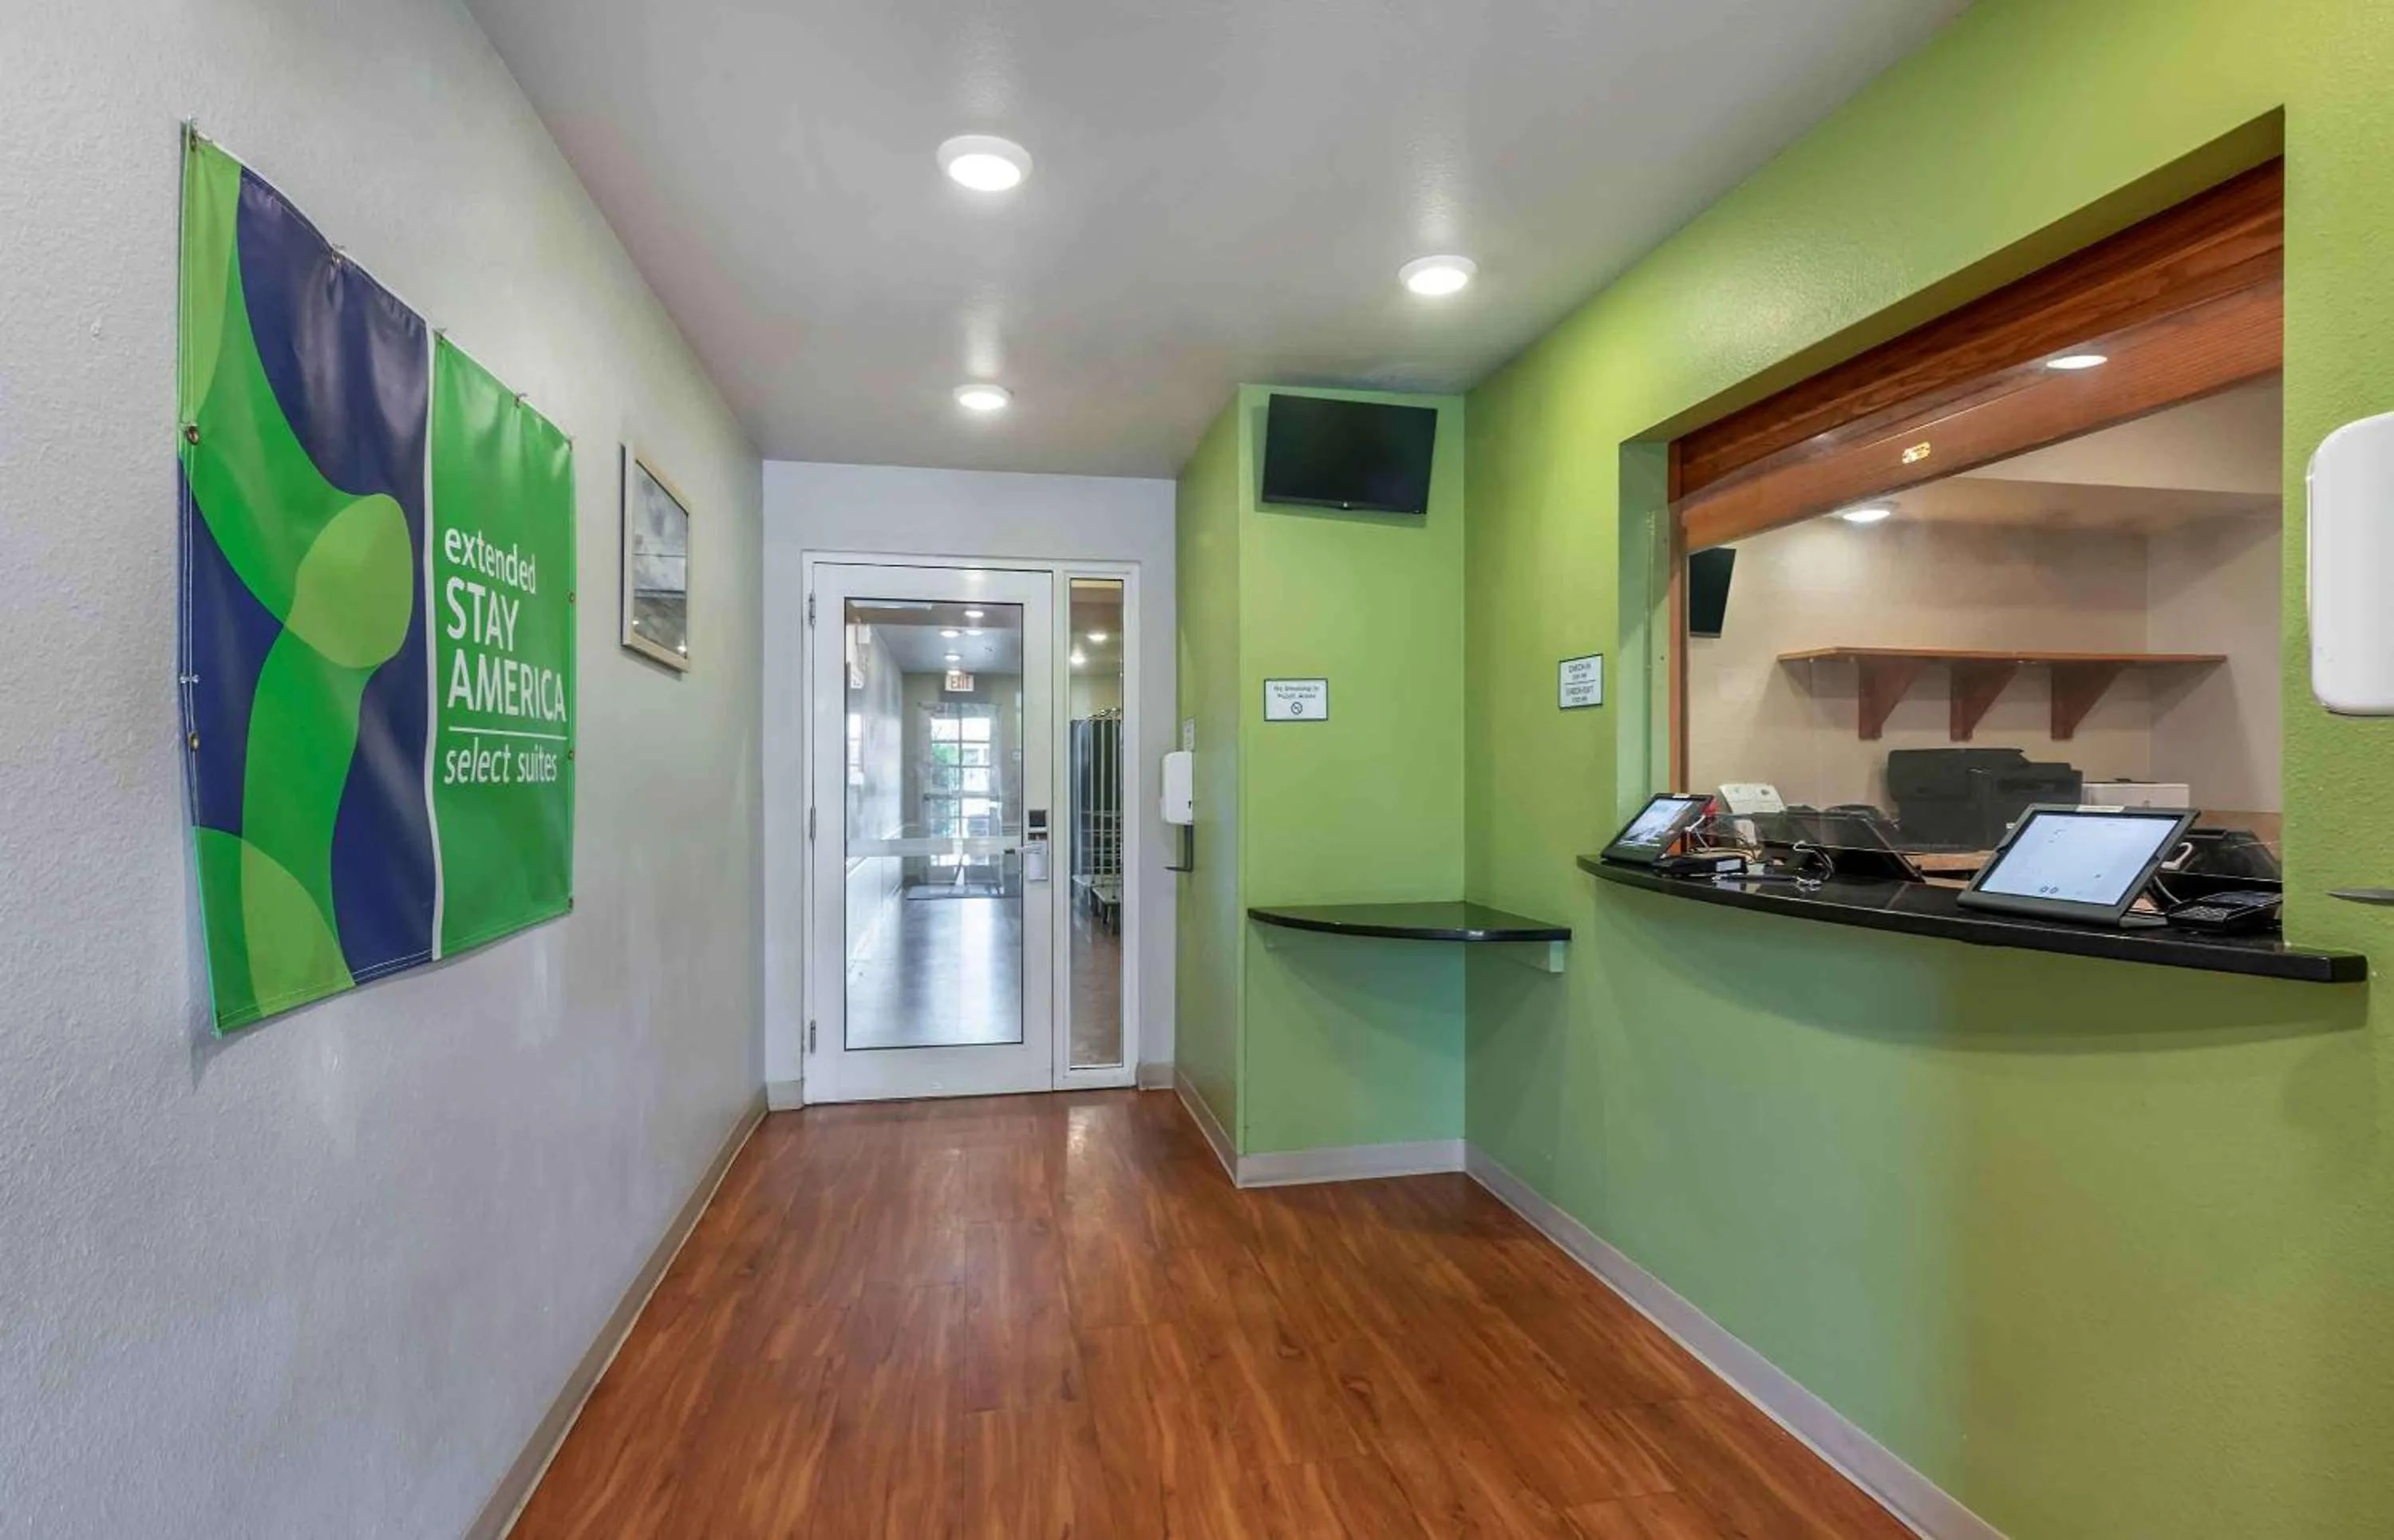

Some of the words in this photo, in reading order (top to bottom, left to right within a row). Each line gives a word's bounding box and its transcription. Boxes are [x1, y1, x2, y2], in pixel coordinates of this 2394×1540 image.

[444, 527, 536, 594] extended
[446, 576, 519, 652] STAY
[447, 649, 567, 722] AMERICA
[950, 676, 970, 690] EXIT
[444, 736, 511, 785] select
[517, 744, 558, 783] suites
